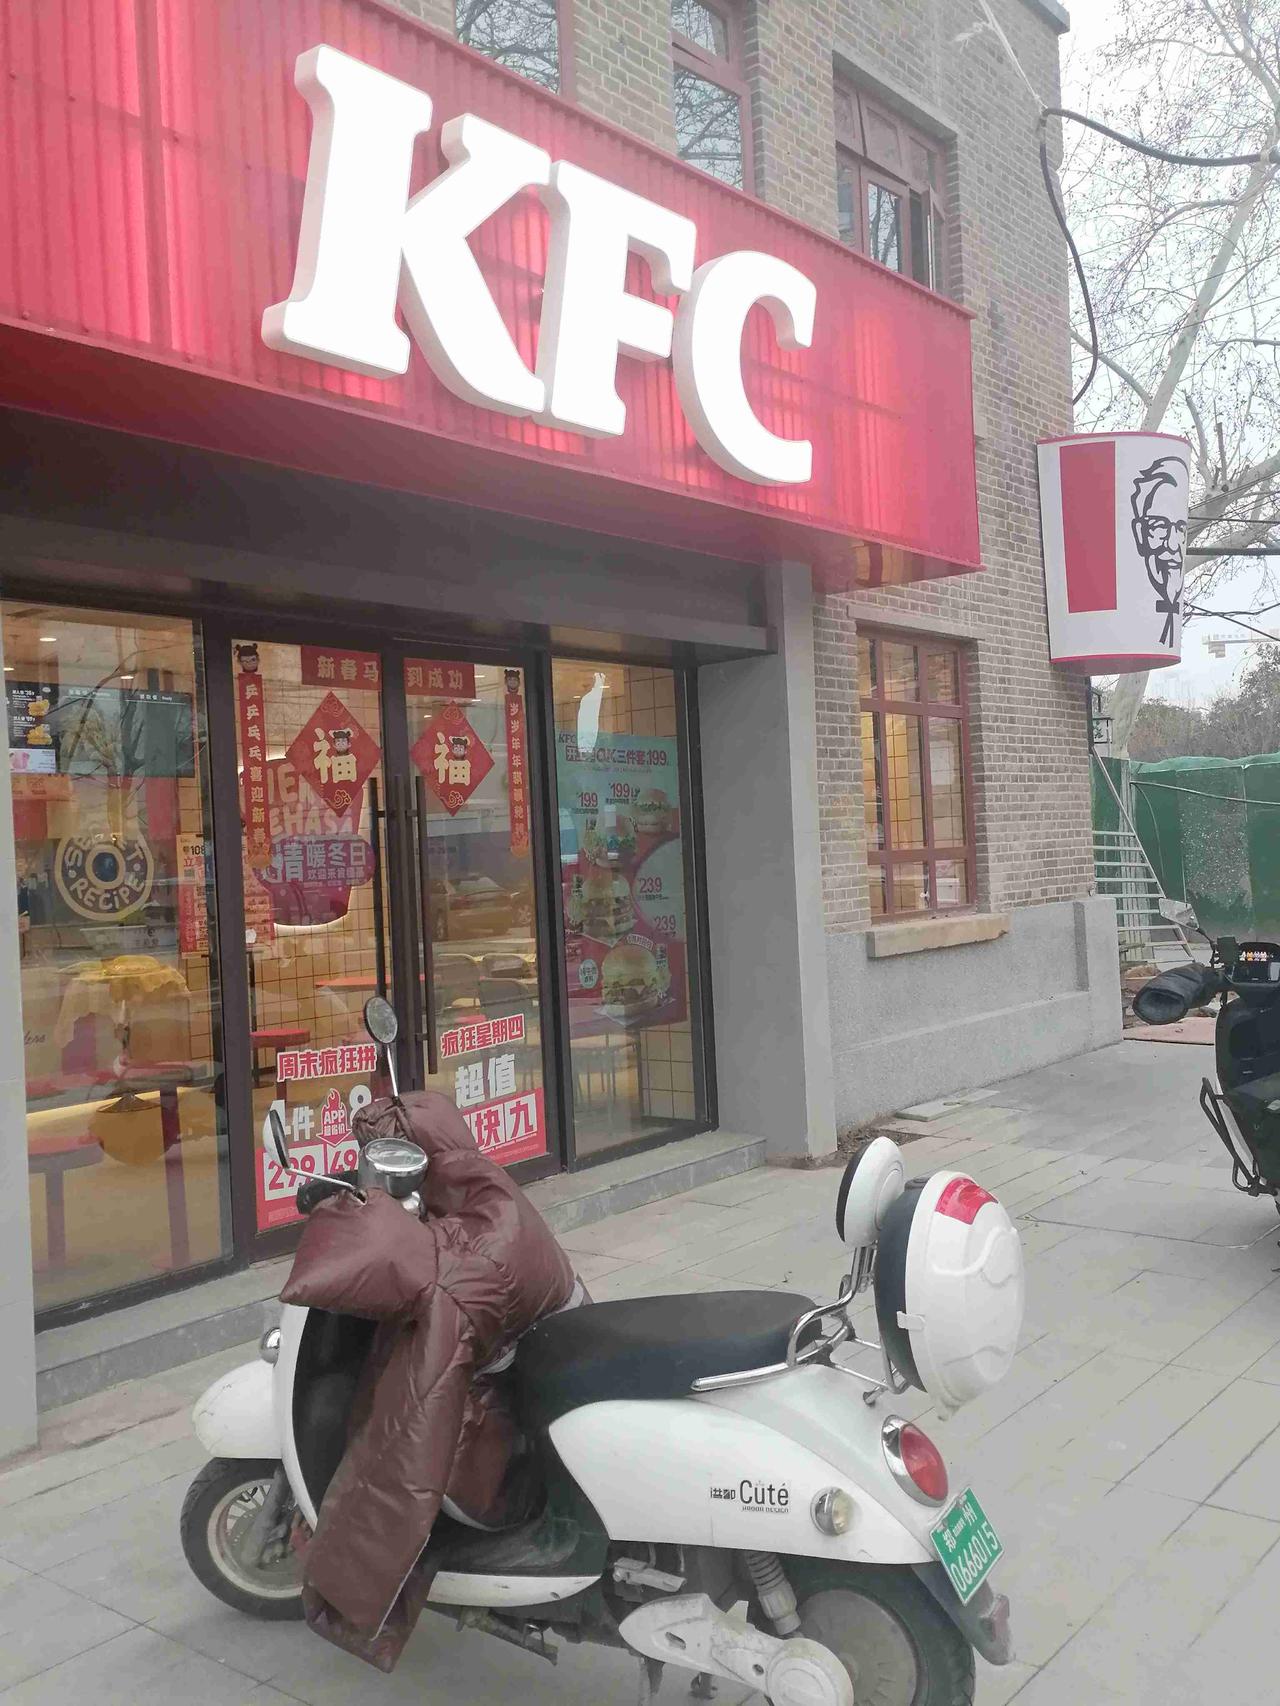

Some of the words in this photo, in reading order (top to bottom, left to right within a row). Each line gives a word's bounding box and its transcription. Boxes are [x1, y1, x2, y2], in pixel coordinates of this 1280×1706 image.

[261, 43, 817, 485] KFC
[317, 655, 379, 682] 新春马
[407, 667, 464, 690] 到成功
[313, 726, 357, 784] 福
[433, 731, 471, 785] 福
[441, 1014, 524, 1058] 疯狂星期四
[278, 1045, 377, 1082] 周末疯狂拼
[455, 1053, 516, 1109] 超值
[324, 1109, 345, 1125] APP
[950, 1521, 999, 1593] 0666015
